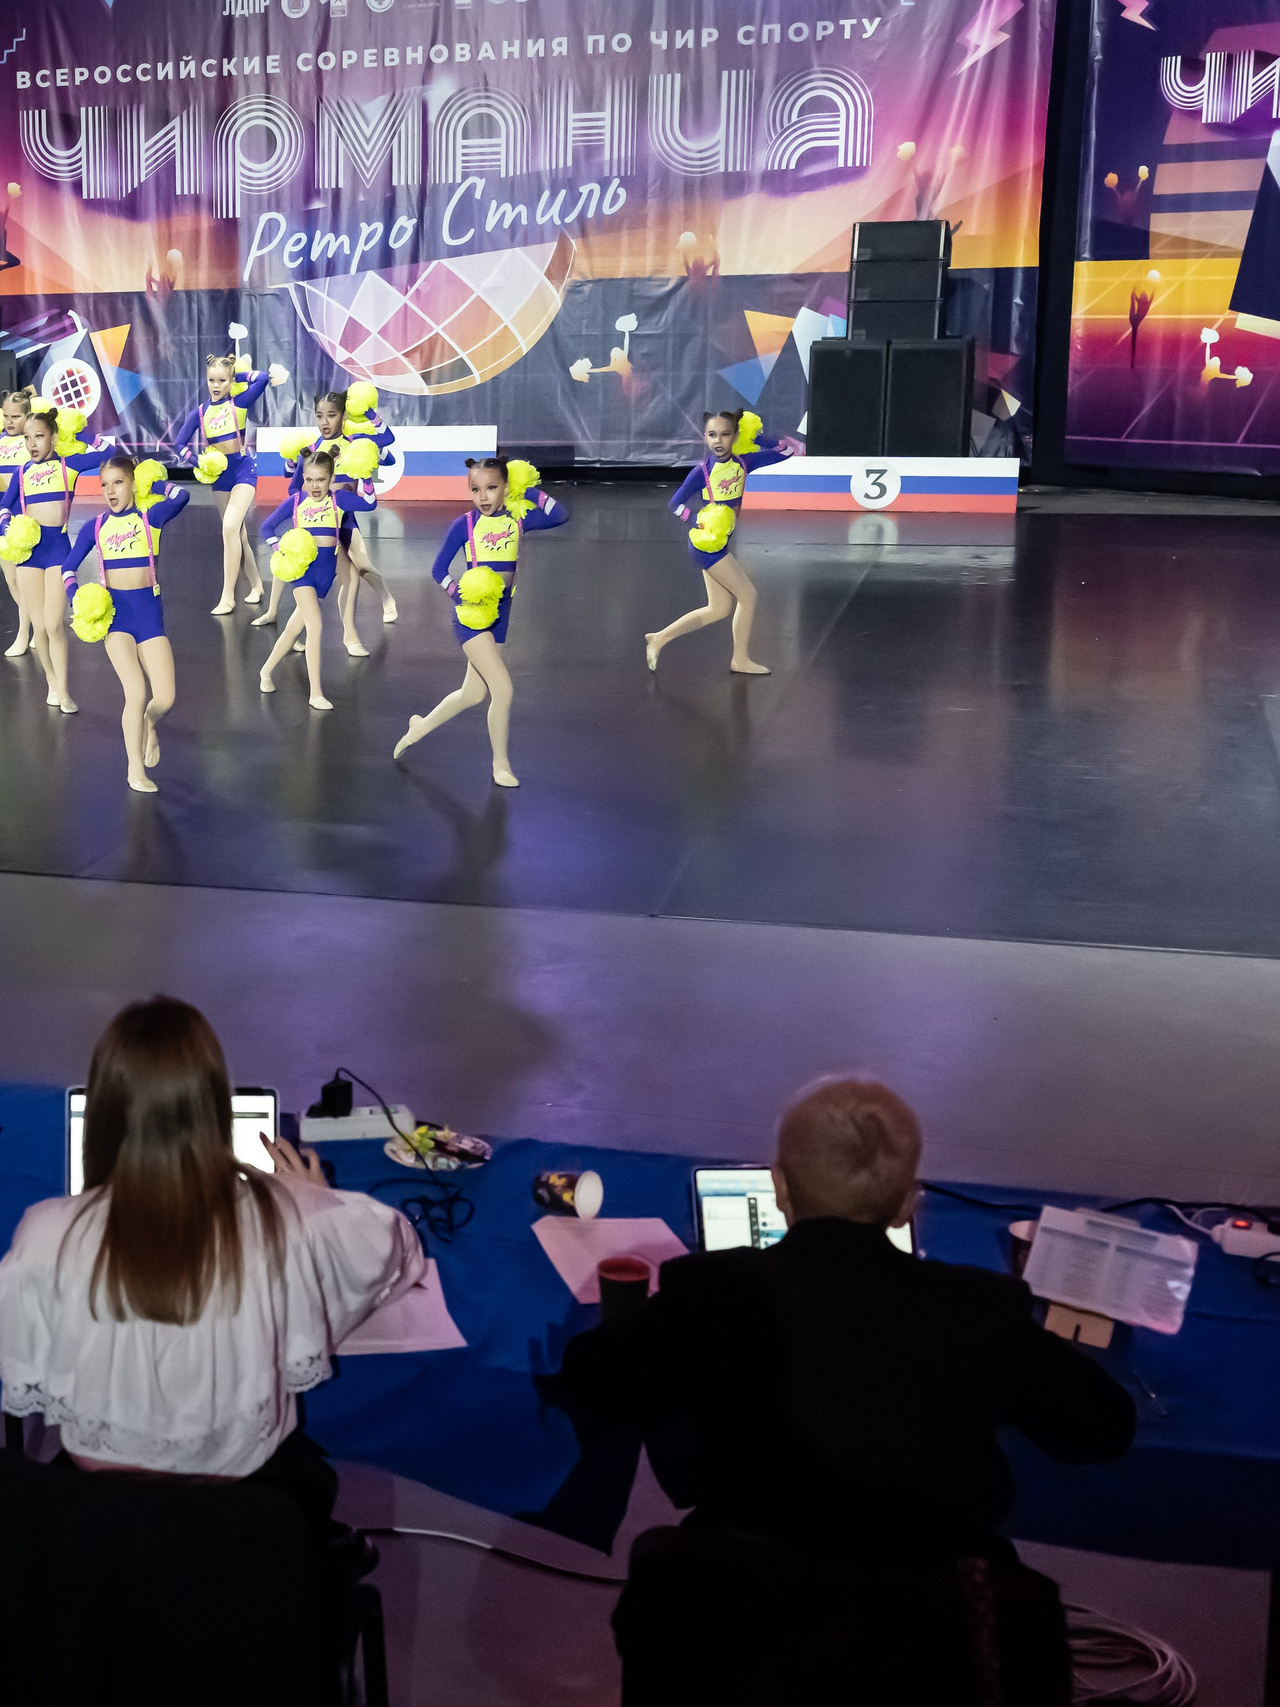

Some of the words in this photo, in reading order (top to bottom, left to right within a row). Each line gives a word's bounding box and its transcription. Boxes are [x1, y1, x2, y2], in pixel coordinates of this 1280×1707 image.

[222, 0, 270, 18] ЛДПР
[15, 54, 281, 90] ВСЕРОССИЙСКИЕ
[296, 35, 569, 72] СОРЕВНОВАНИЯ
[586, 33, 633, 55] ПО
[649, 27, 720, 51] ЧИР
[736, 17, 882, 47] СПОРТУ
[242, 211, 418, 282] Ретро
[441, 175, 628, 246] Стиль
[863, 468, 888, 500] 3
